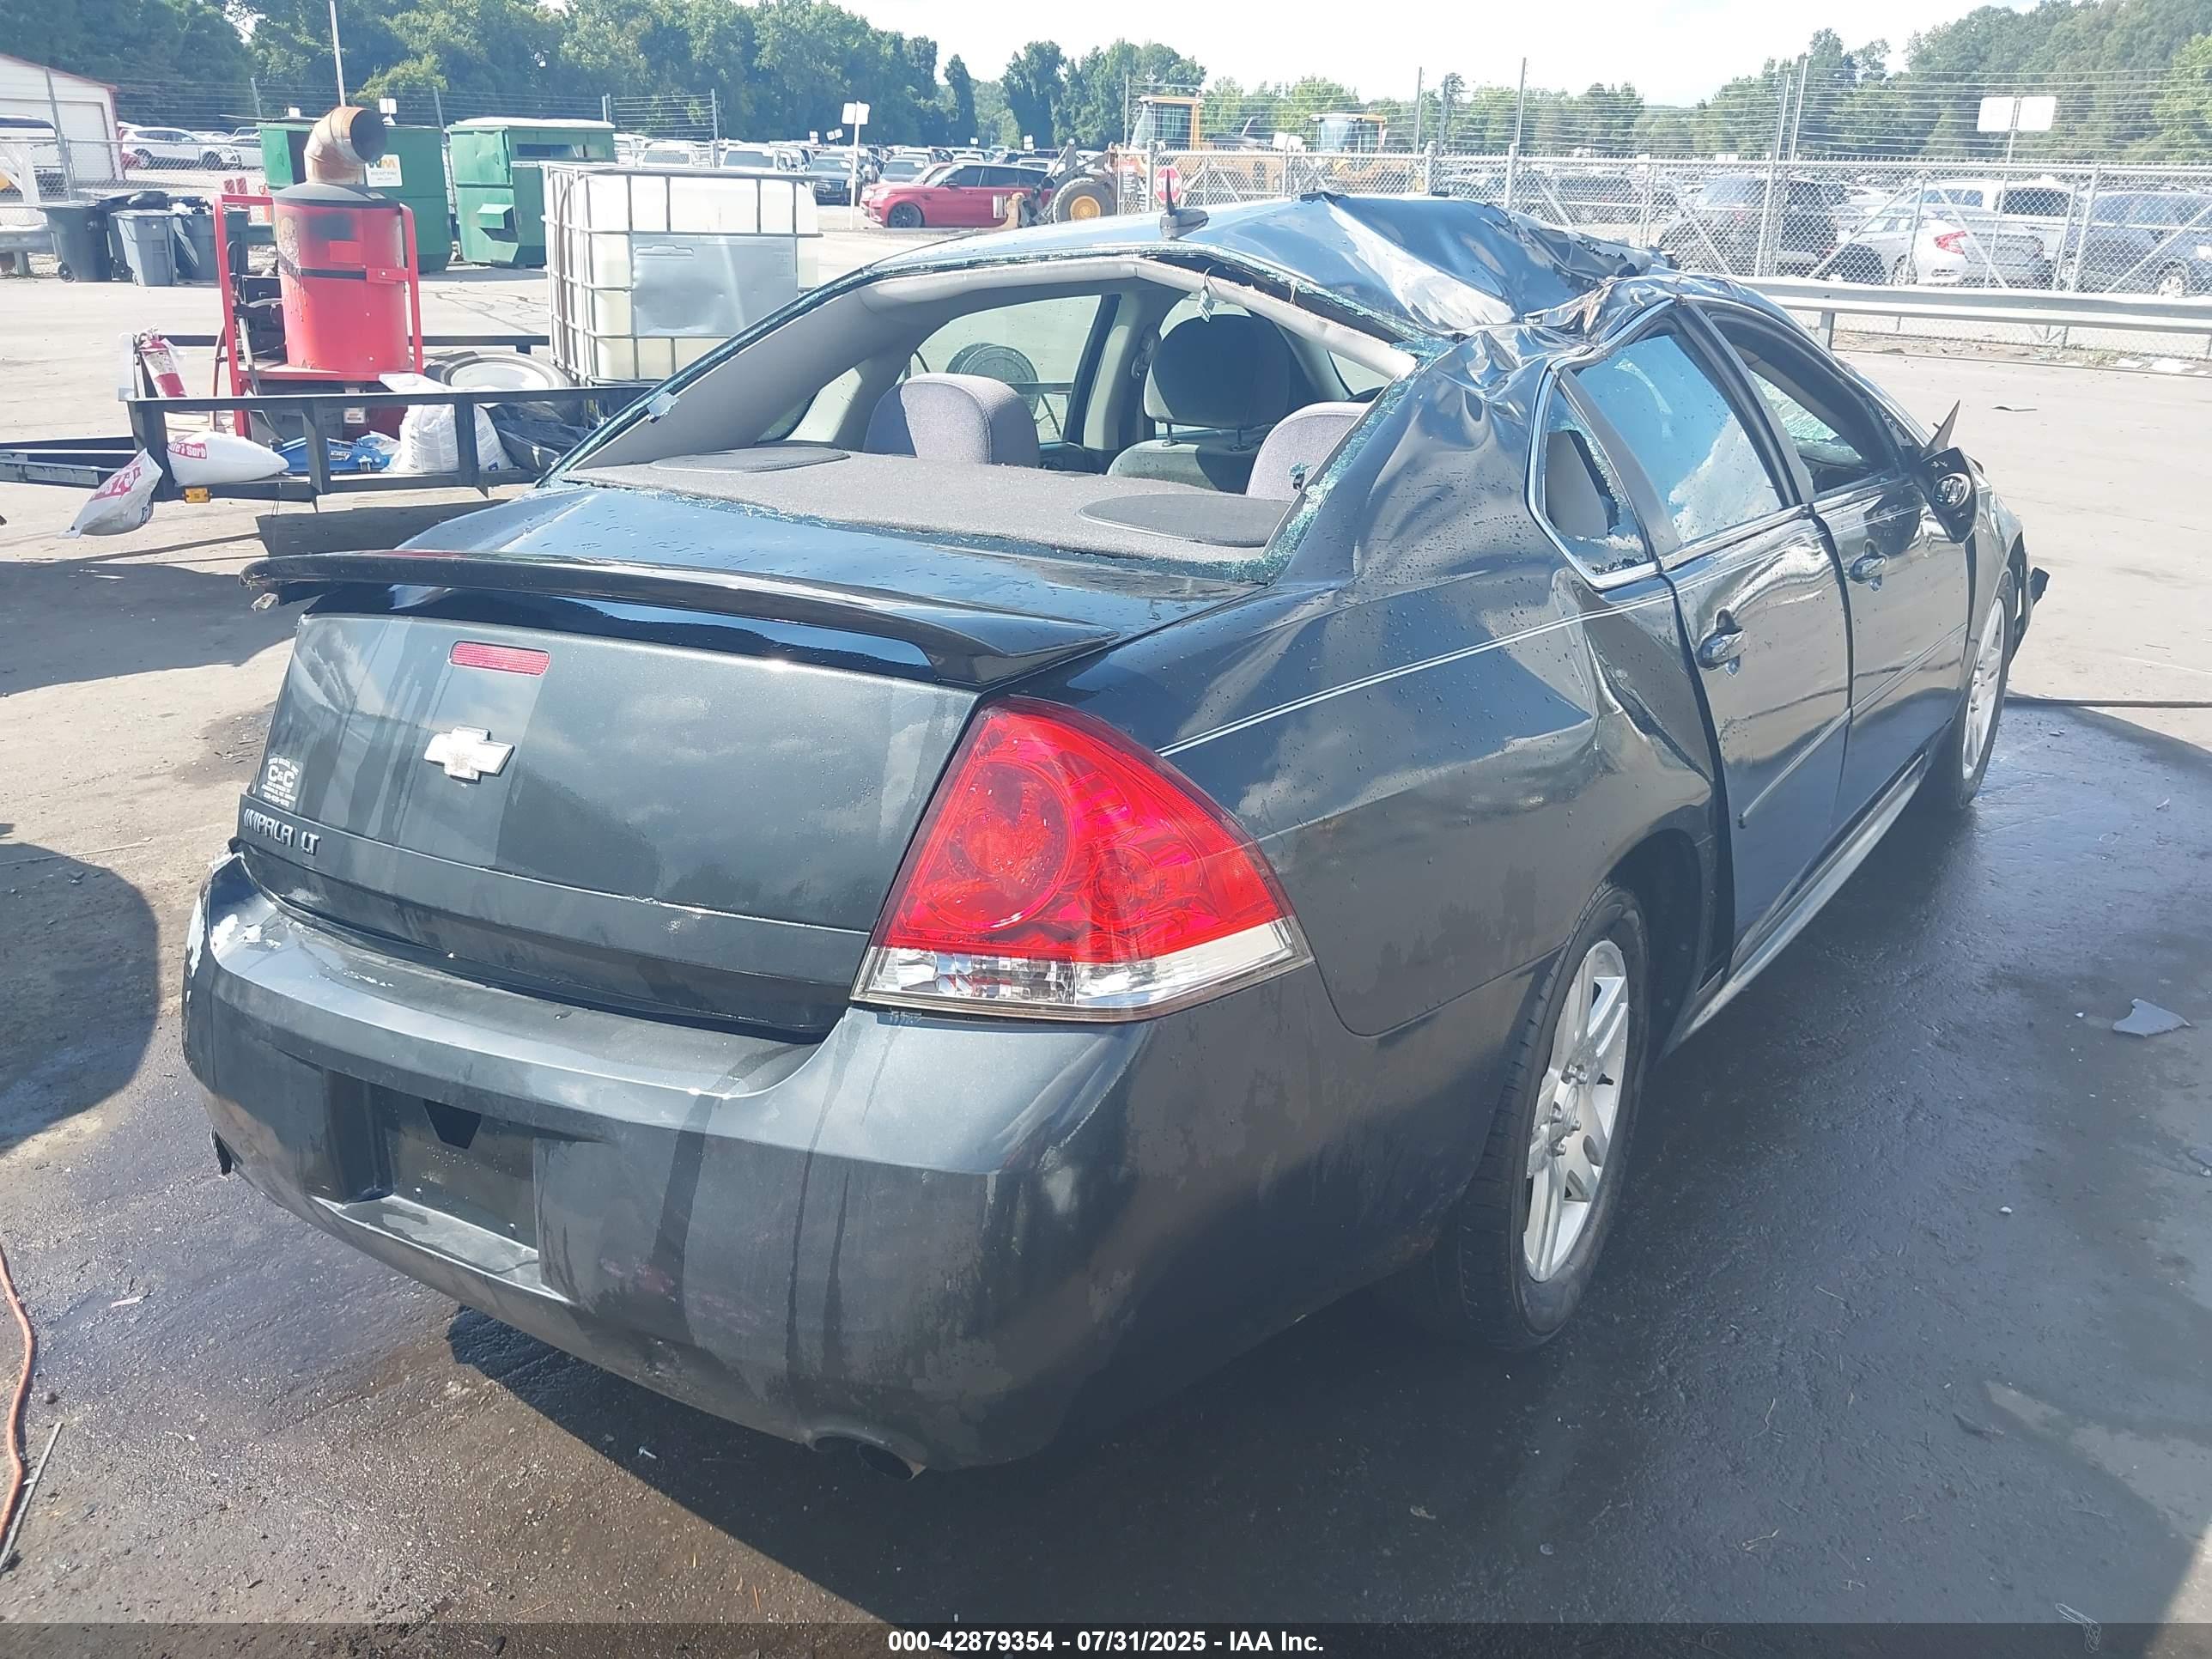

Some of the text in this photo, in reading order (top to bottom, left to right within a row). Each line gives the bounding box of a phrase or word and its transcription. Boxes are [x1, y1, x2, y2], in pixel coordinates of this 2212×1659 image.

[268, 765, 295, 788] C&C
[244, 809, 319, 854] IMPALA LT
